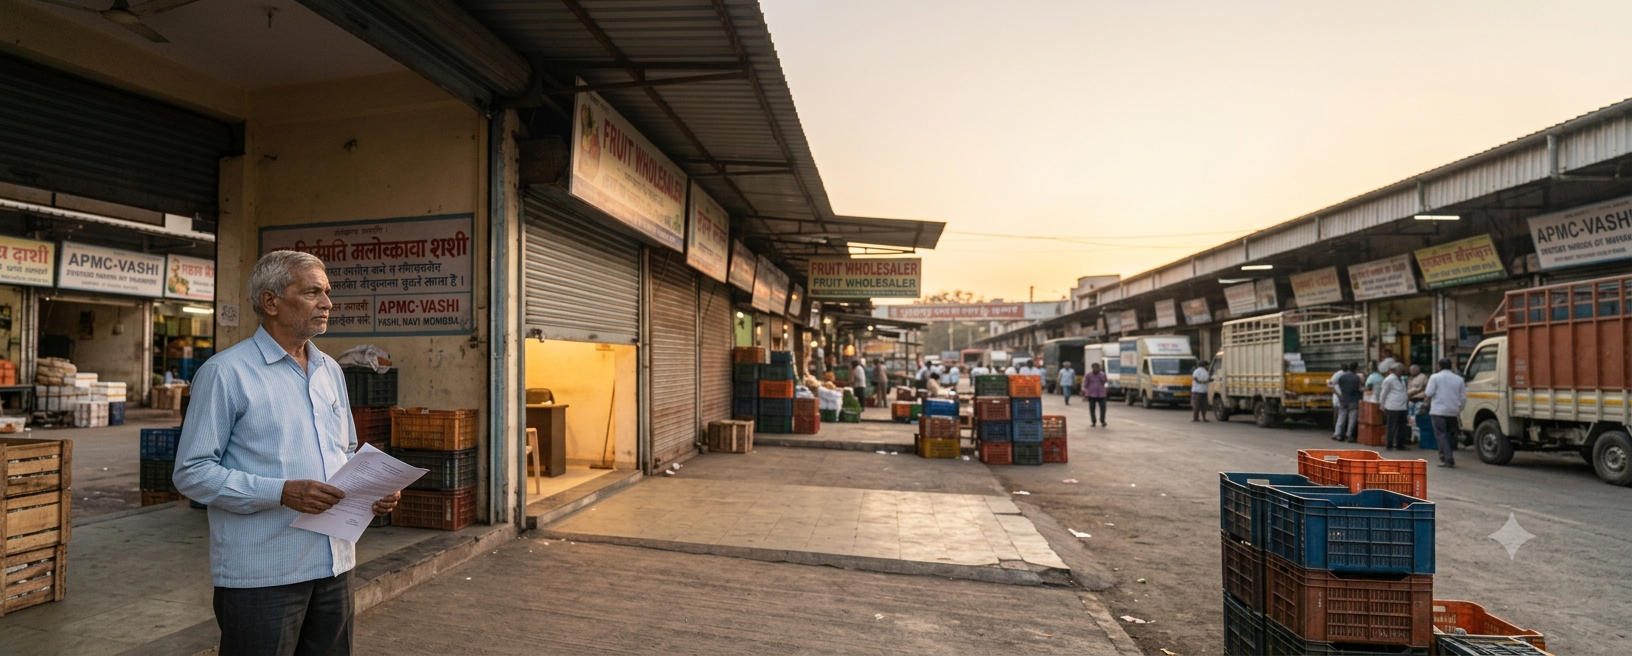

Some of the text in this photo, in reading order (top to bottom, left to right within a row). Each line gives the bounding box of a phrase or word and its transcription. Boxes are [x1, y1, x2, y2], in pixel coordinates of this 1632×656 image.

[603, 119, 633, 168] FRUIT
[635, 144, 684, 205] WHOLESALER
[69, 252, 159, 276] APMC-VASHI
[811, 262, 918, 276] FRUIT WHOLESALER
[813, 278, 916, 288] FRUIT WHOLESALER
